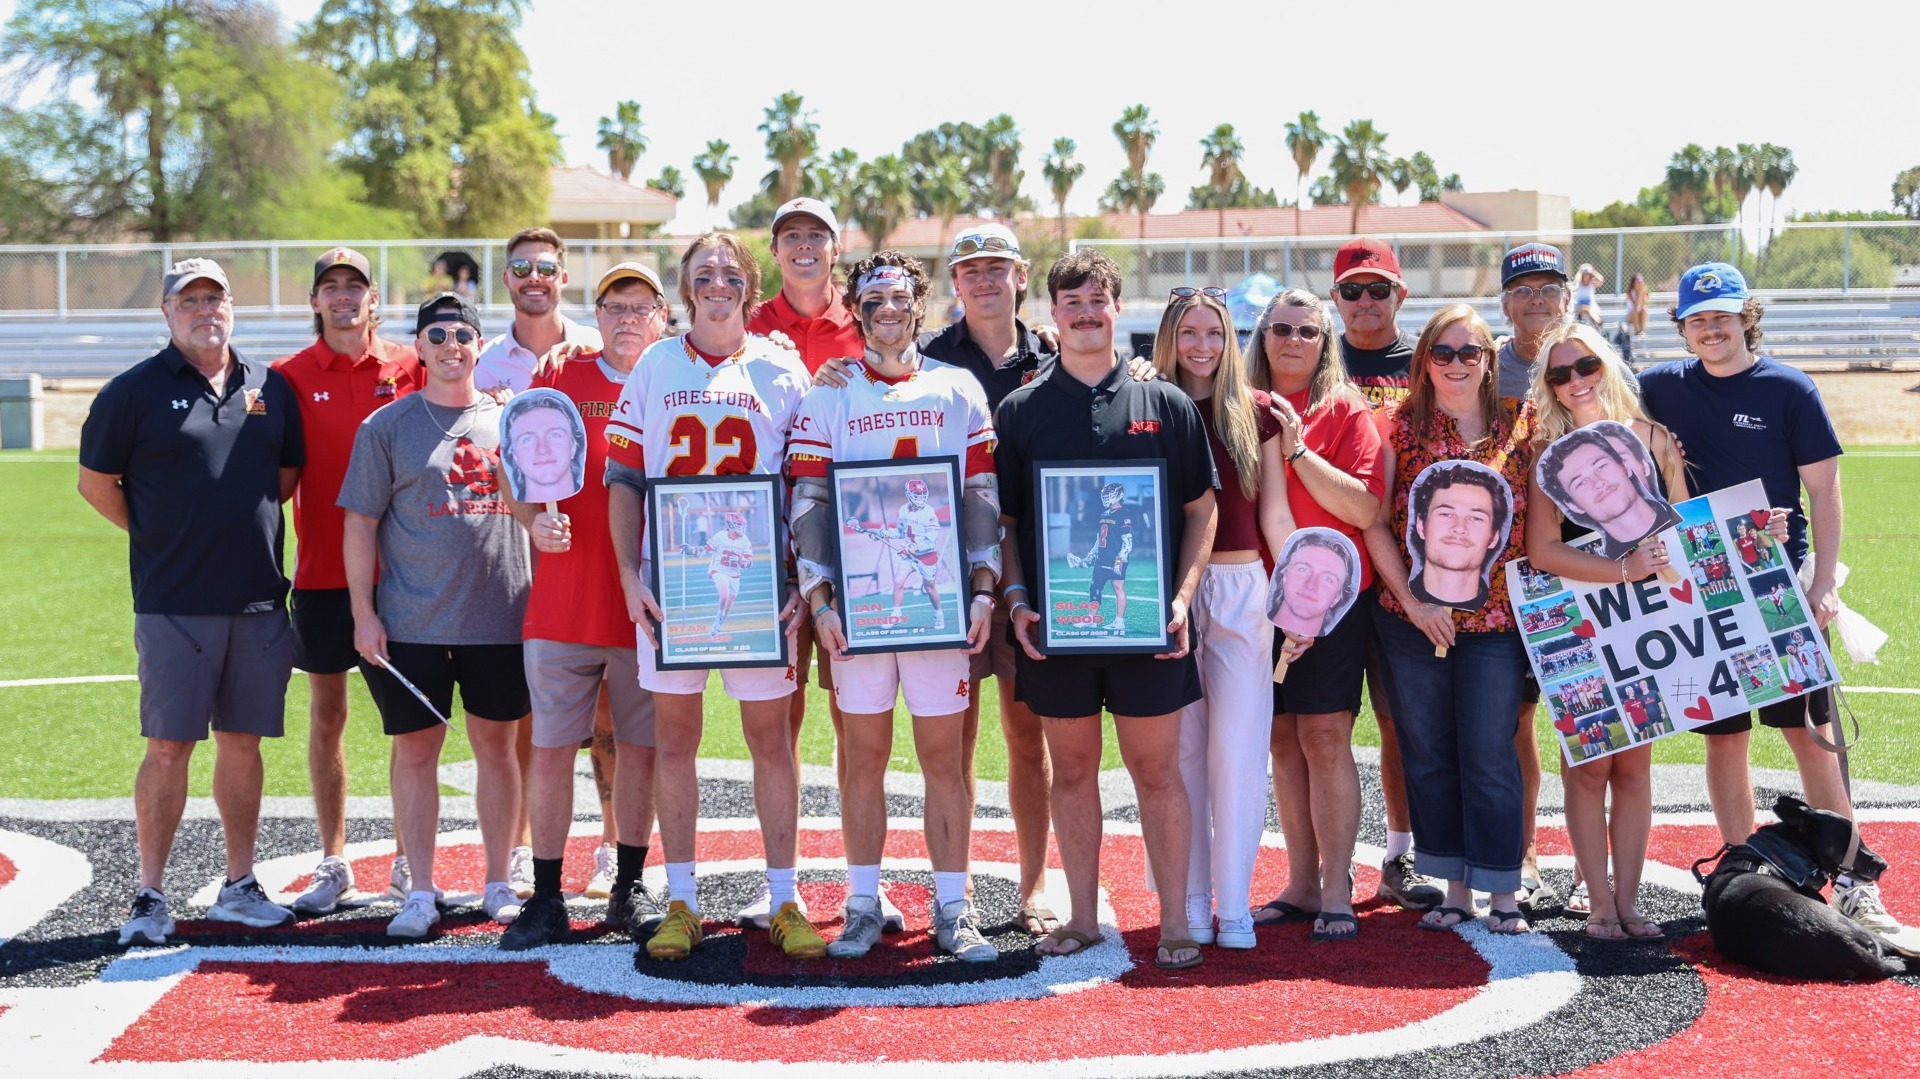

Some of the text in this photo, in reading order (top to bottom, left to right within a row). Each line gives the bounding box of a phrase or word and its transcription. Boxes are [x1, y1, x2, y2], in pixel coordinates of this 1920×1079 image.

[578, 401, 617, 417] FIRE
[664, 390, 761, 414] FIRESTORM
[848, 410, 945, 436] FIRESTORM
[1733, 413, 1750, 423] ITL
[665, 414, 757, 477] 22
[854, 603, 882, 613] IAN
[1055, 601, 1100, 610] SILAS
[1584, 573, 1668, 629] WE
[855, 615, 910, 626] BUNDY
[1056, 615, 1104, 625] WOOD
[669, 625, 707, 633] RYAN
[1601, 608, 1746, 683] LOVE
[1671, 660, 1740, 703] # 4
